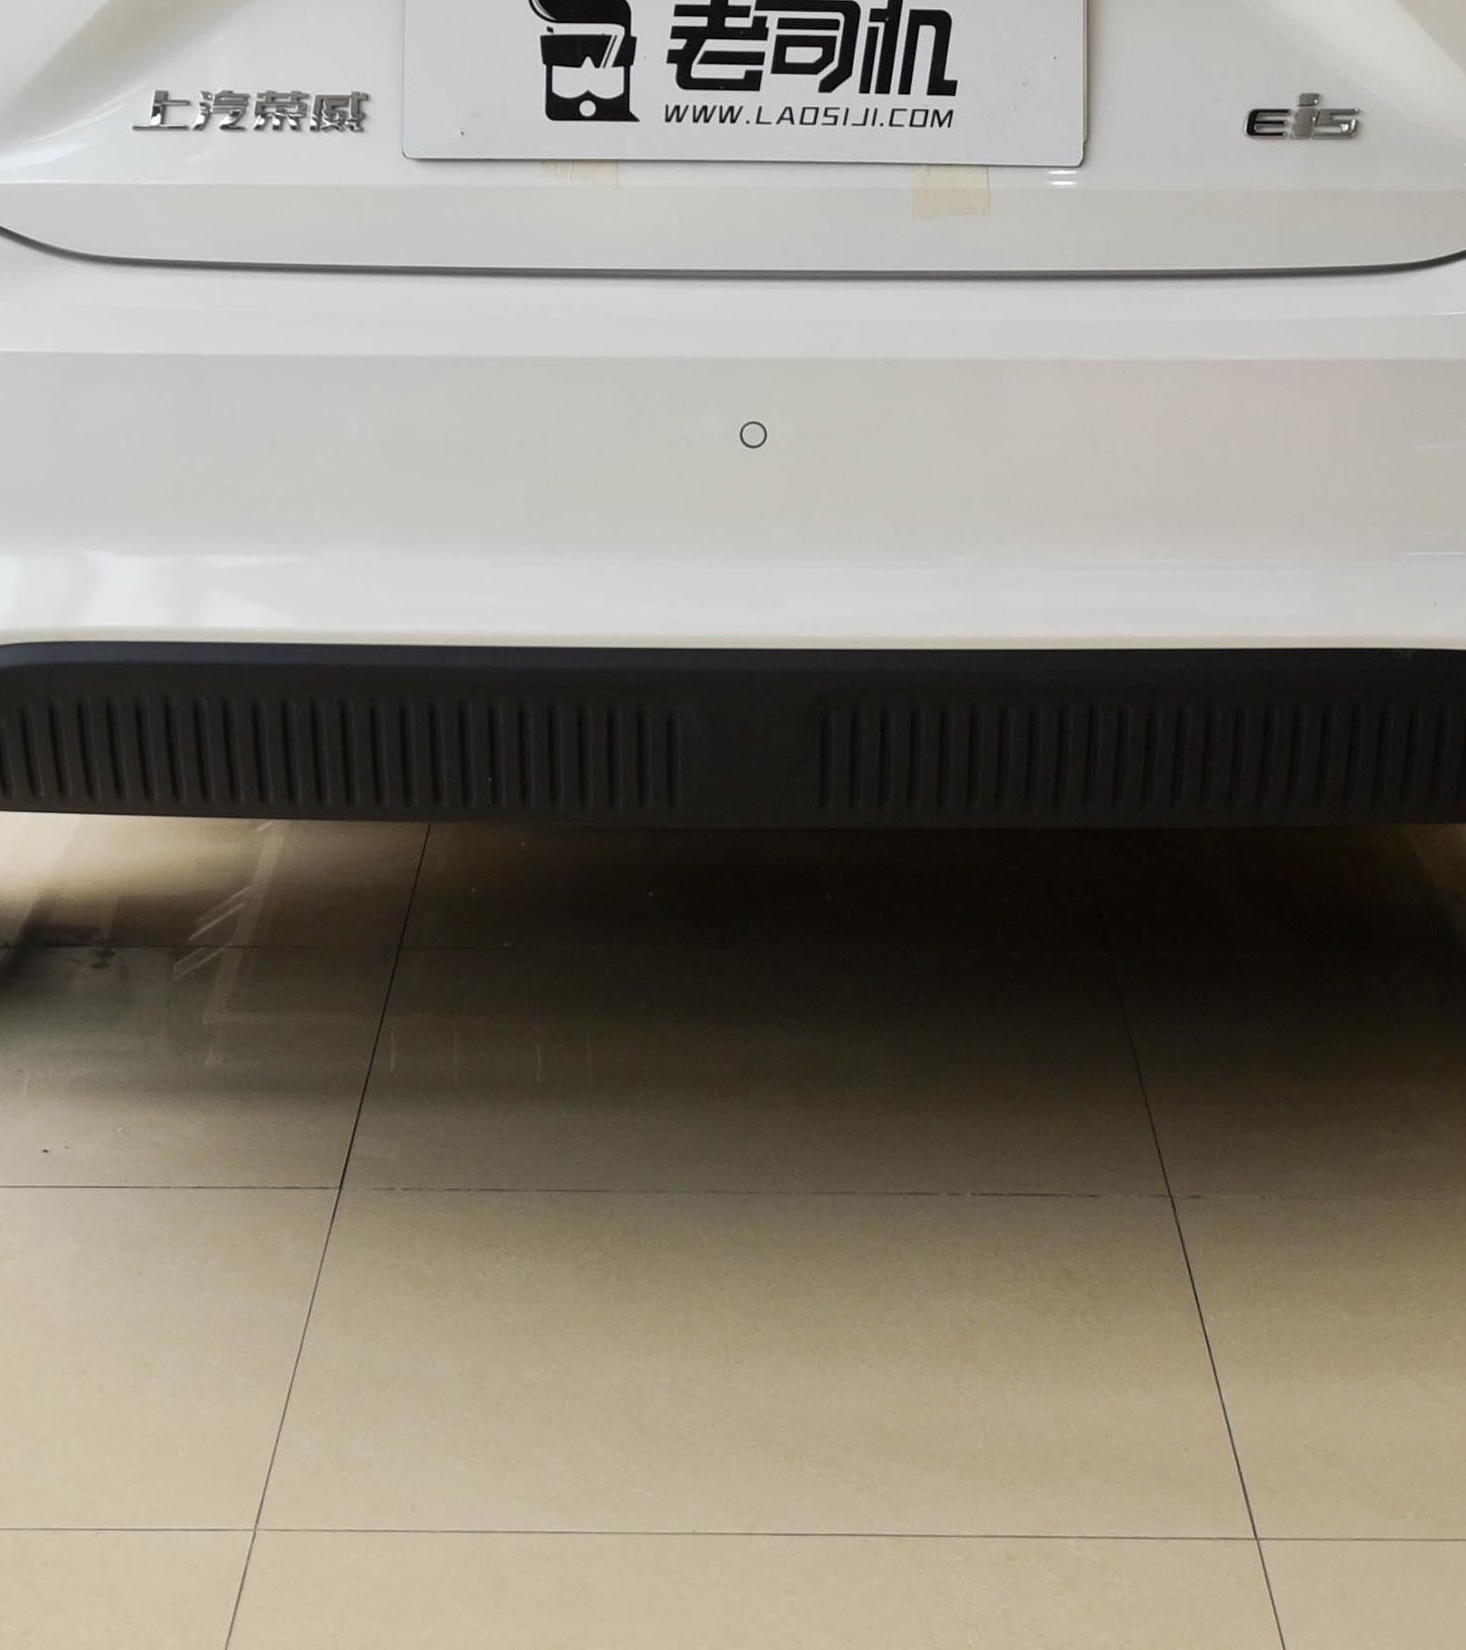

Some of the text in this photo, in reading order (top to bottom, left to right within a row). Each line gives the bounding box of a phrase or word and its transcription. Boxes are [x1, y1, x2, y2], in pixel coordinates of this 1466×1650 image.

[133, 90, 370, 132] 上汽荣威
[664, 104, 954, 128] WWW.LAOSIJI.COM
